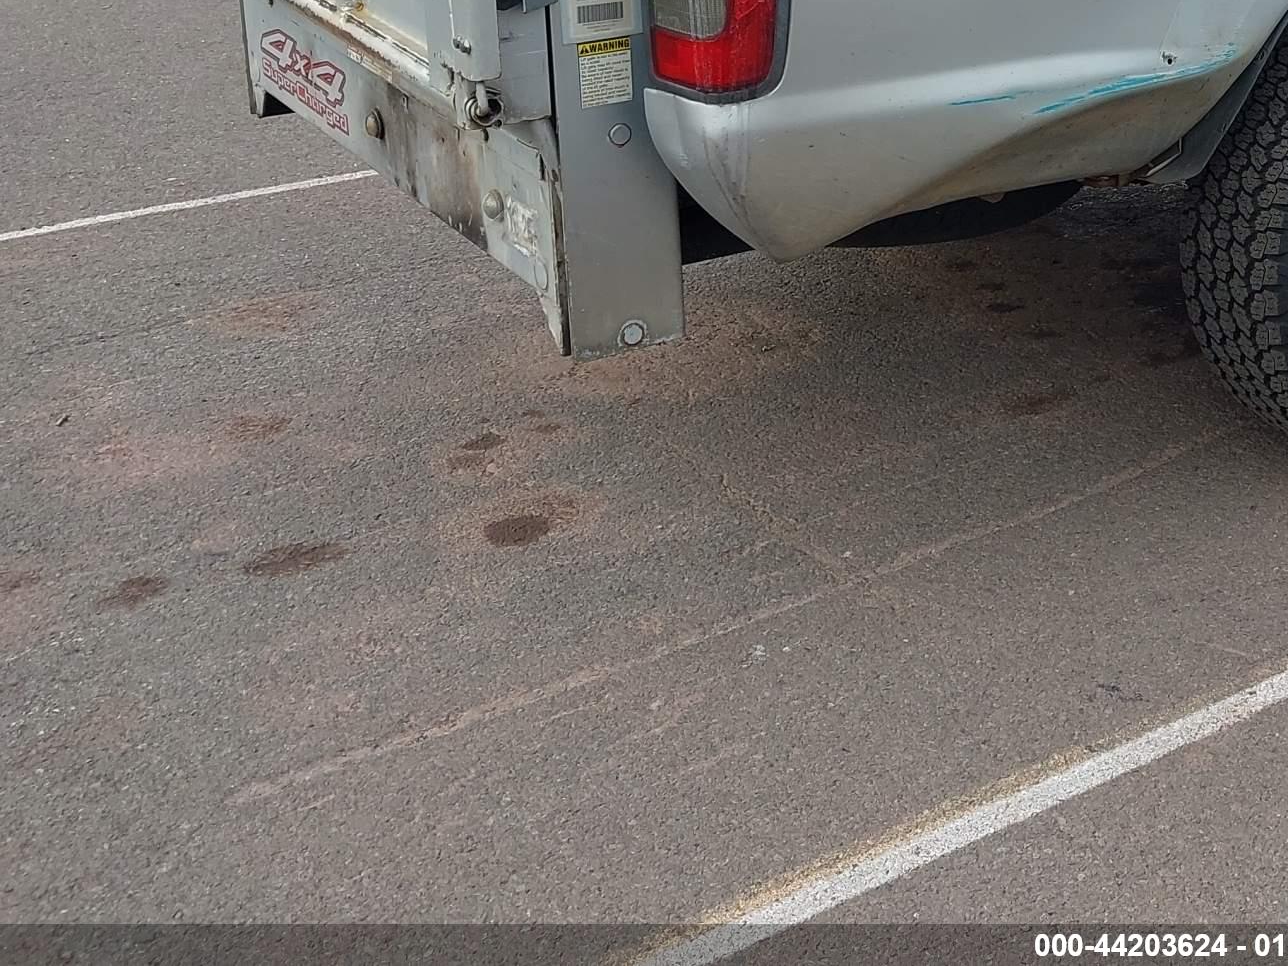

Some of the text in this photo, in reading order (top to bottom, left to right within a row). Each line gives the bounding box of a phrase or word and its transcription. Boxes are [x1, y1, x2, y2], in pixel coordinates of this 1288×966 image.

[261, 28, 347, 109] 4x4
[589, 38, 630, 53] WARNING
[261, 57, 350, 136] SuperCharged
